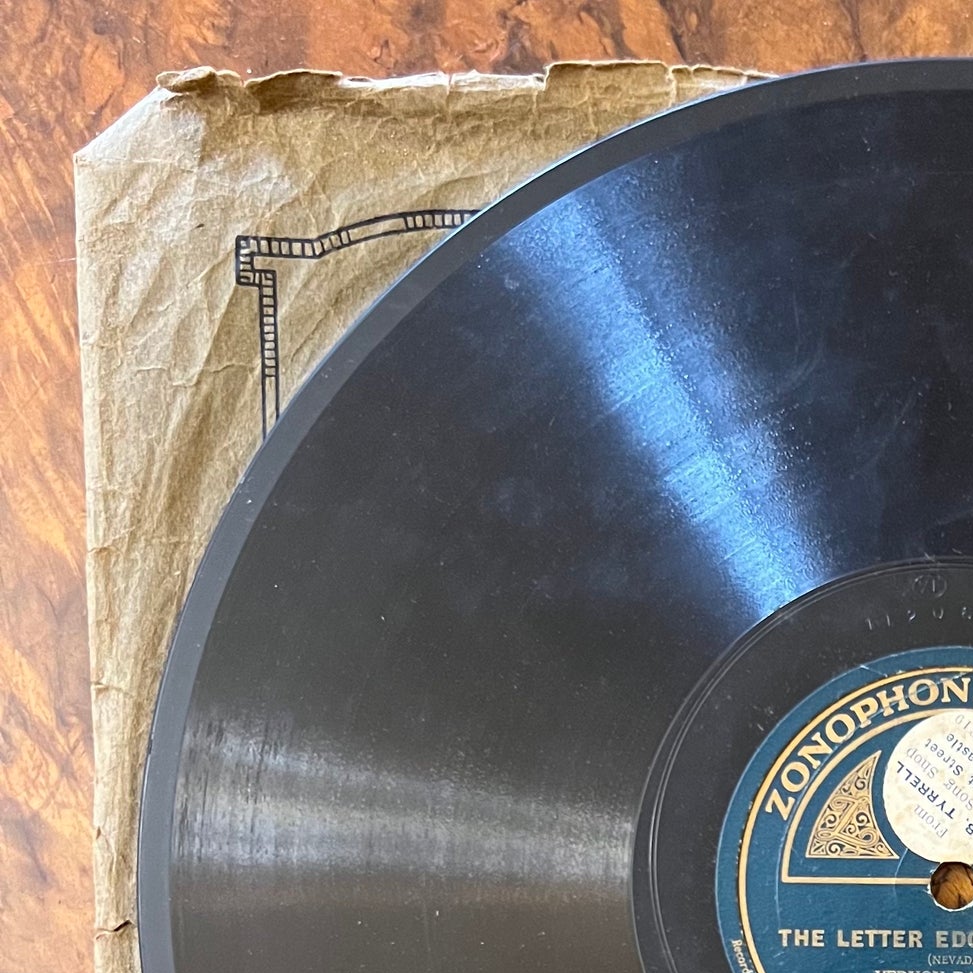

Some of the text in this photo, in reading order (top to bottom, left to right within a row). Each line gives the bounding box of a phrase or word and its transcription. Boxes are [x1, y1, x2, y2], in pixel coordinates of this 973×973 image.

[906, 747, 939, 780] Shop
[924, 738, 964, 776] Street
[896, 760, 956, 820] TYRRELL
[914, 803, 949, 839] From
[778, 929, 825, 948] THE
[837, 929, 923, 949] LETTER
